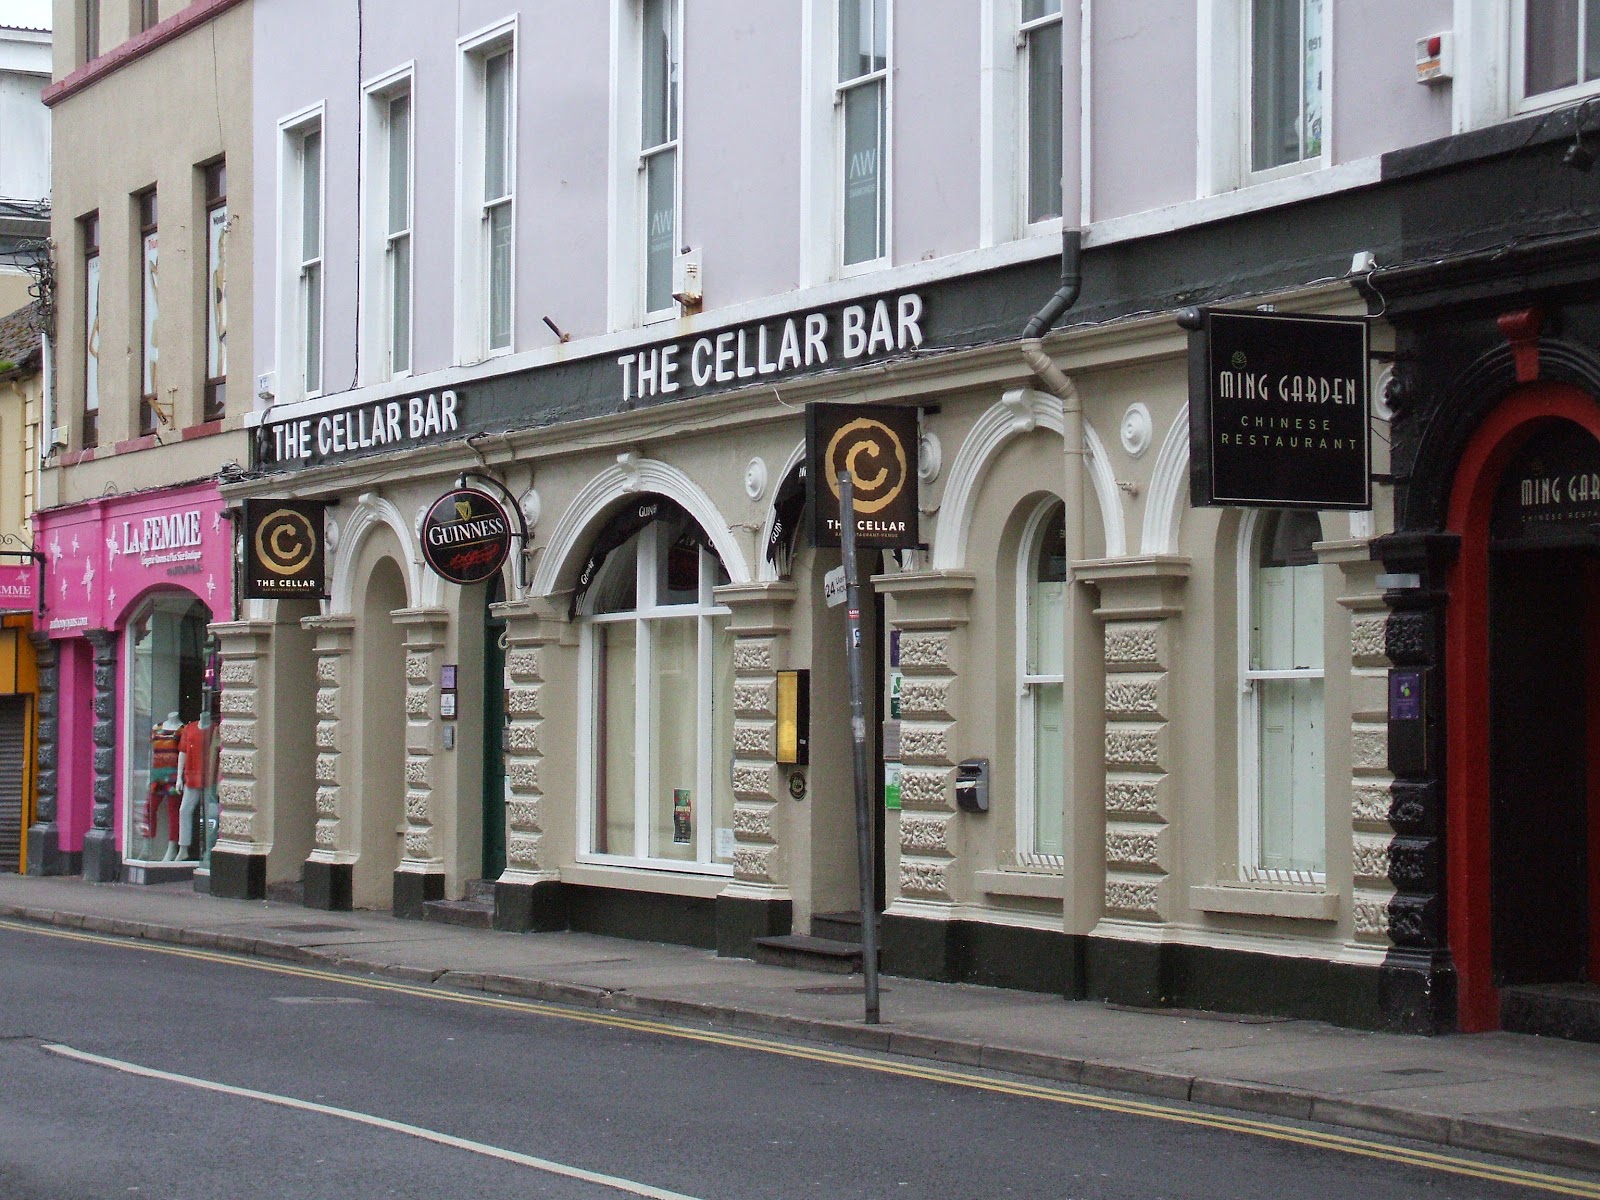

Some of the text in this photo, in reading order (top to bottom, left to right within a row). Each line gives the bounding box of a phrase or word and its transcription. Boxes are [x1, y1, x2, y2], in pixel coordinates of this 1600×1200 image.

[616, 292, 924, 402] THE CELLAR BAR
[1219, 370, 1356, 405] MING GARDEN
[272, 389, 459, 462] THE CELLAR BAR
[1240, 415, 1331, 431] CHINESE
[1220, 433, 1357, 450] RESTAURANT
[1521, 476, 1561, 506] MING
[142, 510, 202, 552] FEMME
[428, 517, 504, 546] GUINNESS
[857, 520, 906, 532] CELLAR
[0, 585, 31, 595] MME
[256, 579, 316, 588] THE CELLAR
[826, 581, 836, 598] 24
